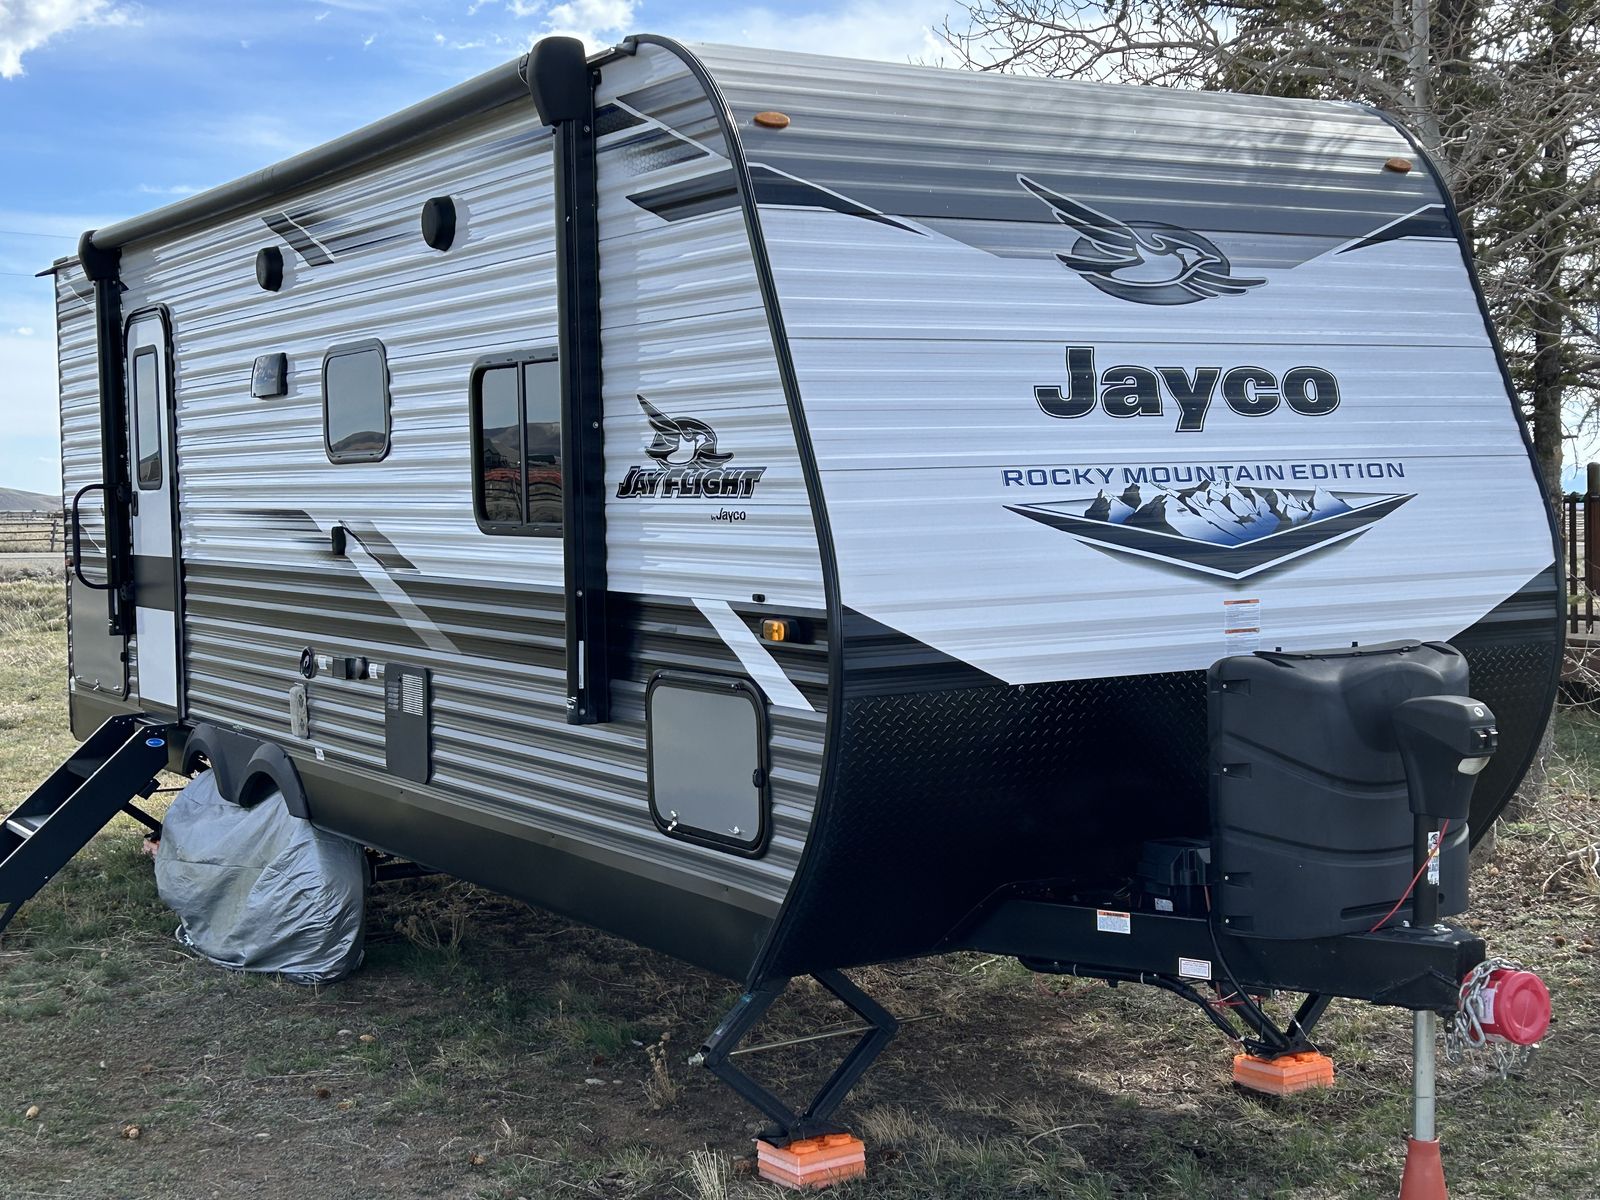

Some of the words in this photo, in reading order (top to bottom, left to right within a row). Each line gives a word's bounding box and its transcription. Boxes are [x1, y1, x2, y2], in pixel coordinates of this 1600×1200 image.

[1033, 346, 1341, 432] Jayco
[616, 466, 668, 498] JAY
[661, 467, 767, 498] FLIGHT
[1001, 468, 1114, 486] ROCKY
[1122, 465, 1284, 483] MOUNTAIN
[1290, 463, 1405, 480] EDITION
[716, 507, 746, 523] Jayco
